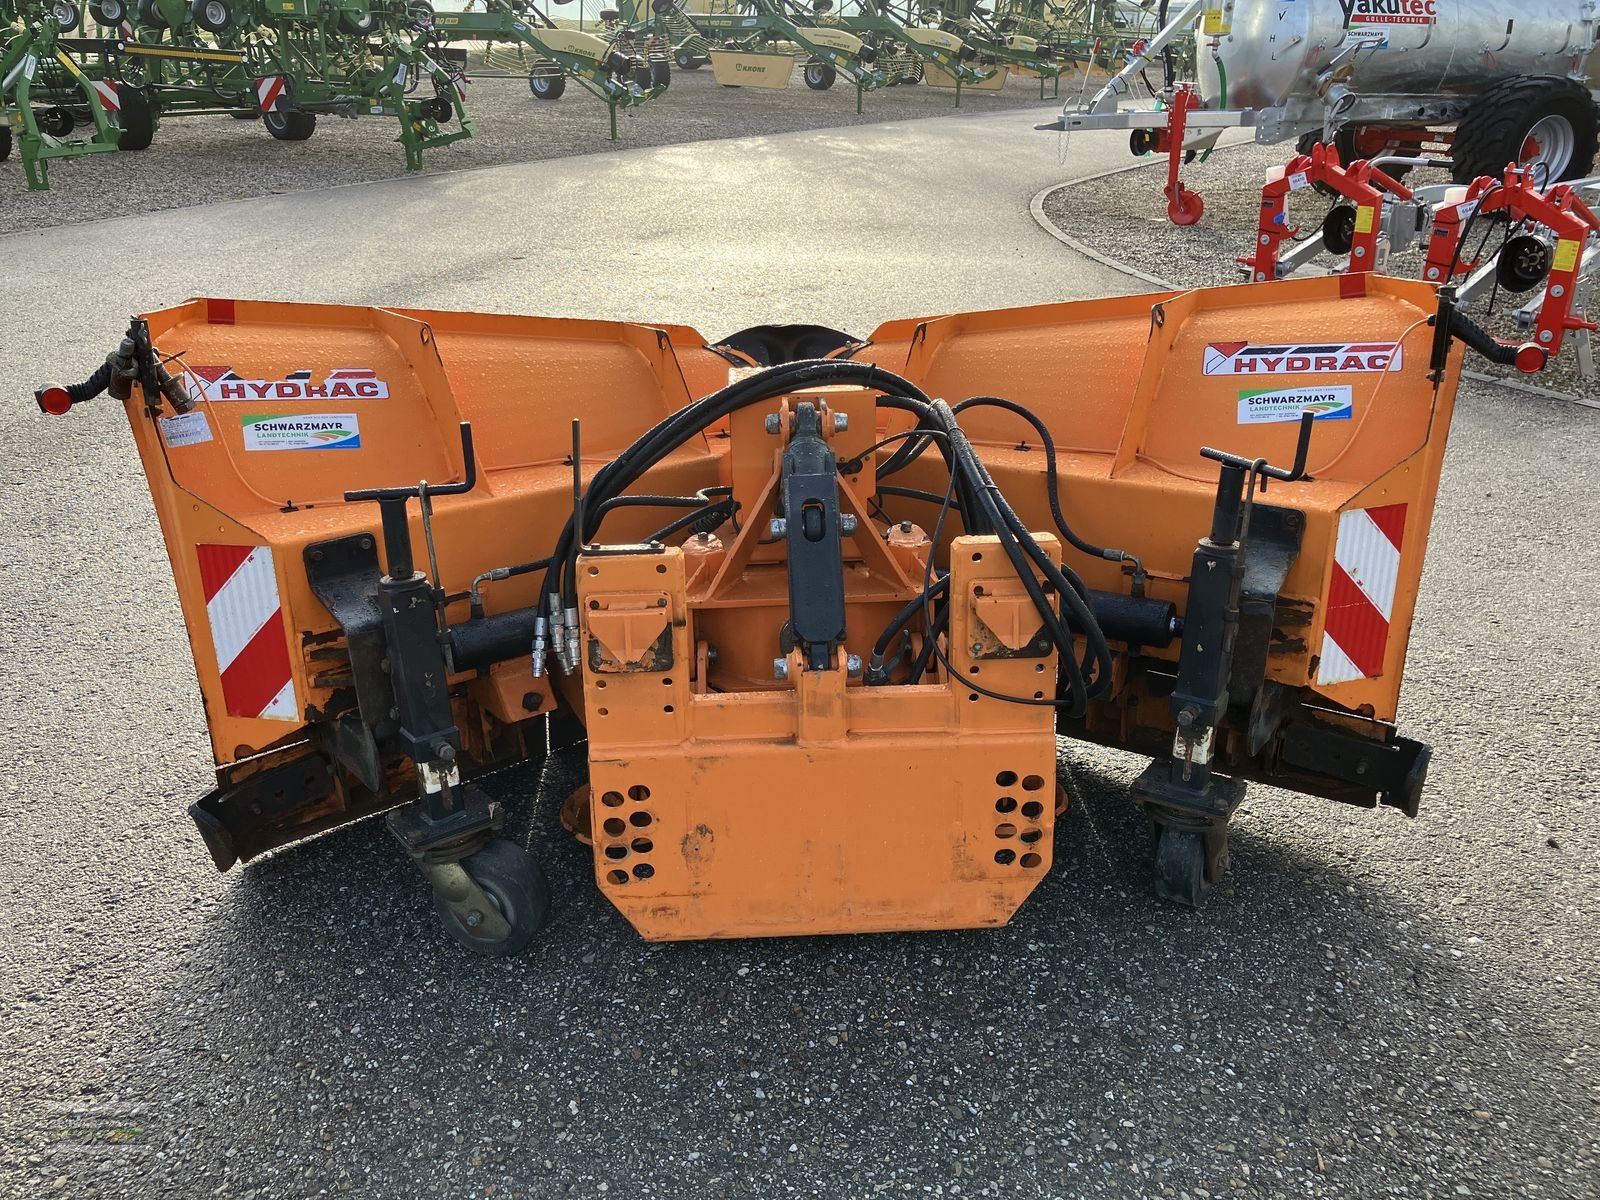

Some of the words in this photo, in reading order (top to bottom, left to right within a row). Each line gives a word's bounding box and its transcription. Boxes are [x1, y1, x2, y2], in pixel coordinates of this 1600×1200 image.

[1234, 354, 1391, 373] HYDRAC
[220, 382, 379, 399] HYDRAC
[1248, 394, 1336, 405] SCHWARZMAYR
[254, 422, 343, 431] SCHWARZMAYR
